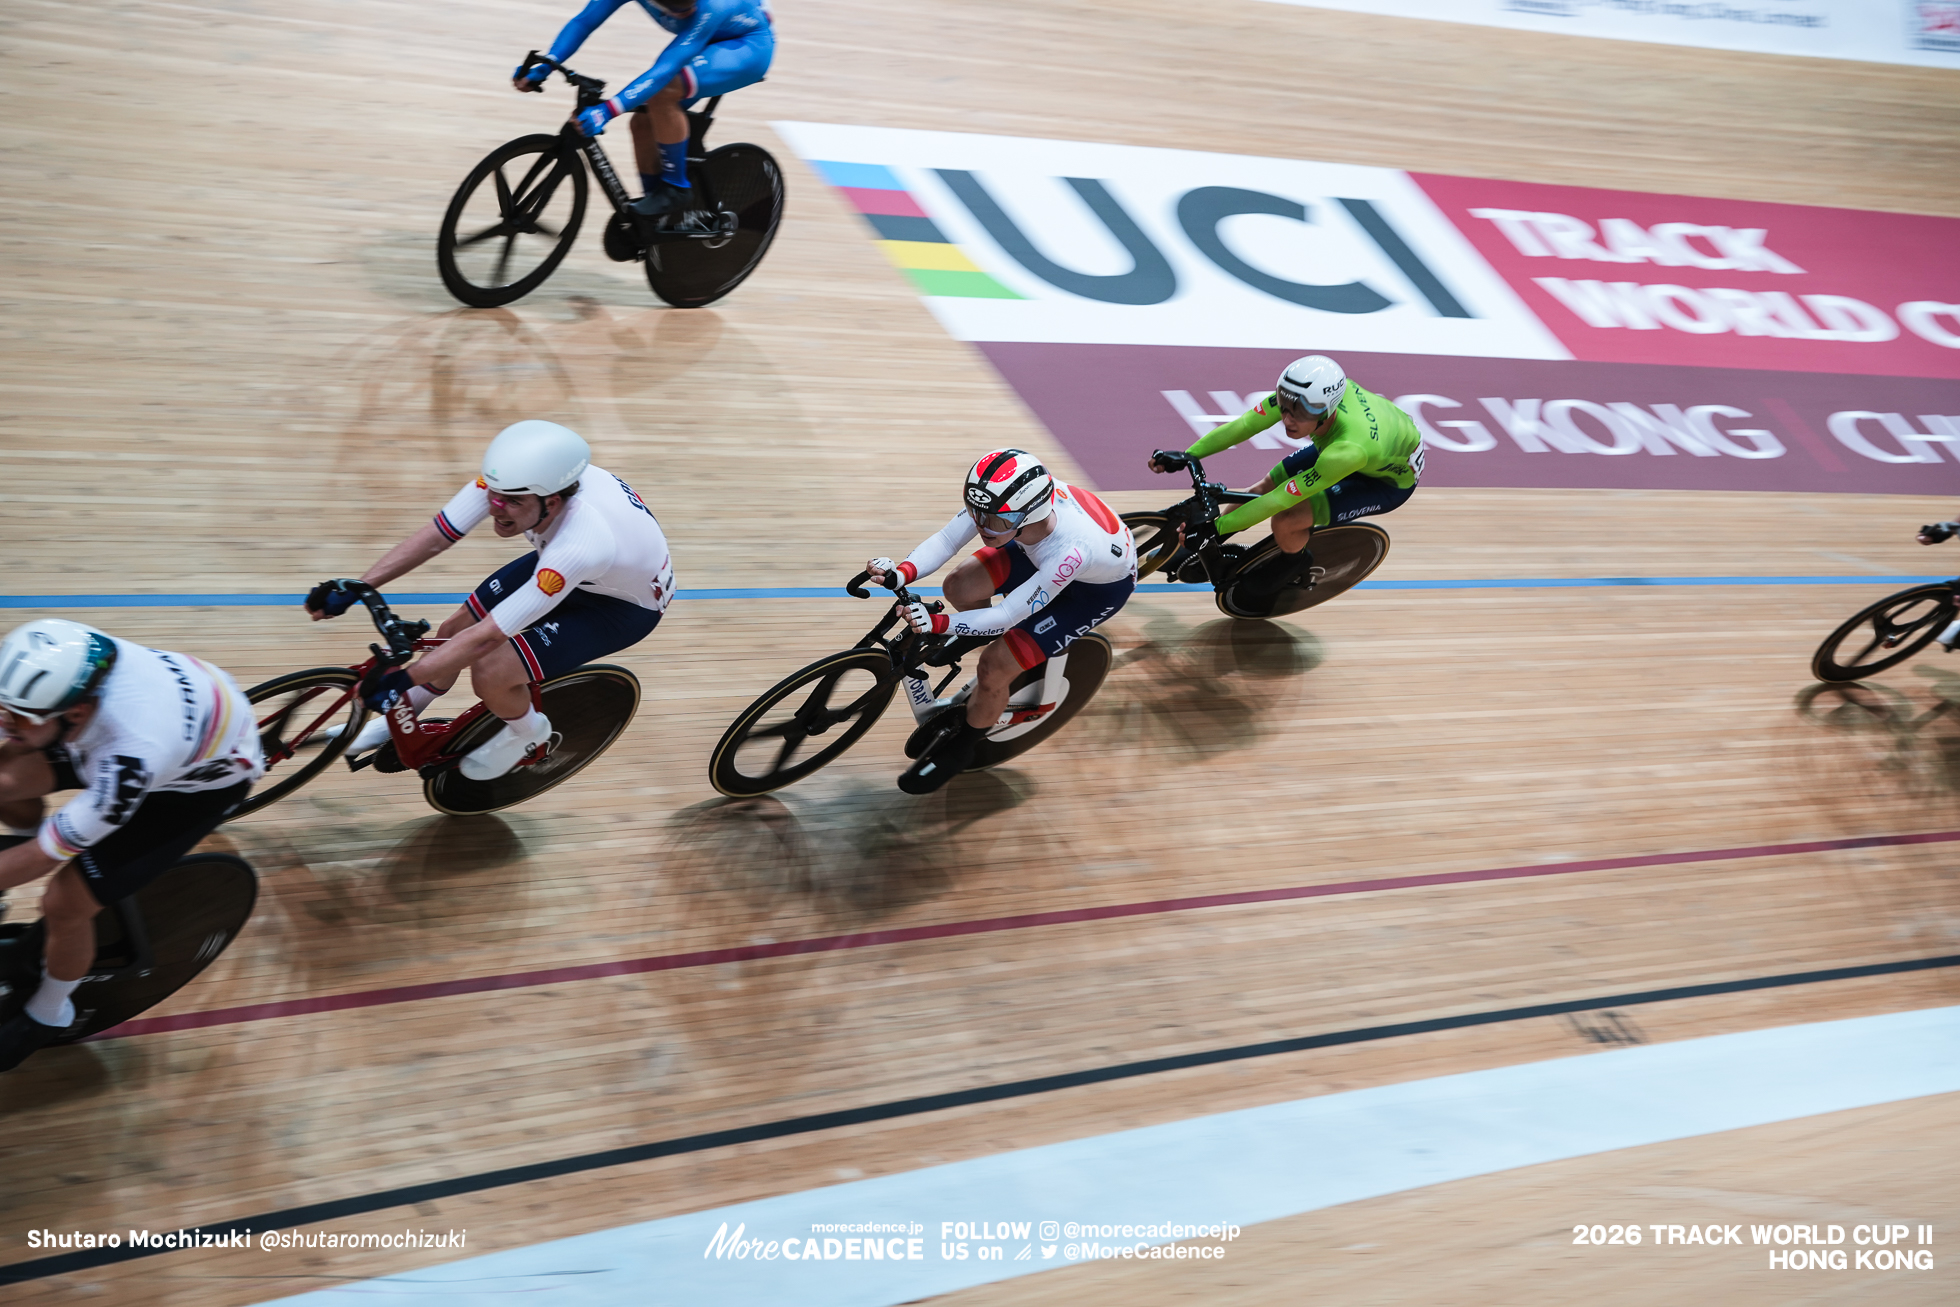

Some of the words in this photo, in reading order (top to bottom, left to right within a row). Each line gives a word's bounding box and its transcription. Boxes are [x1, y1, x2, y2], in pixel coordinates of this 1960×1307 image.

[923, 167, 1488, 319] UCI
[1466, 207, 1808, 275] TRACK
[1531, 276, 1900, 343] WORLD
[1322, 378, 1346, 396] RUD
[1477, 397, 1787, 460] KONG
[1337, 504, 1382, 522] SLOVENIA
[1026, 585, 1043, 606] KEIRIN
[971, 626, 1005, 637] Cyclers
[1052, 606, 1115, 655] JAPAN
